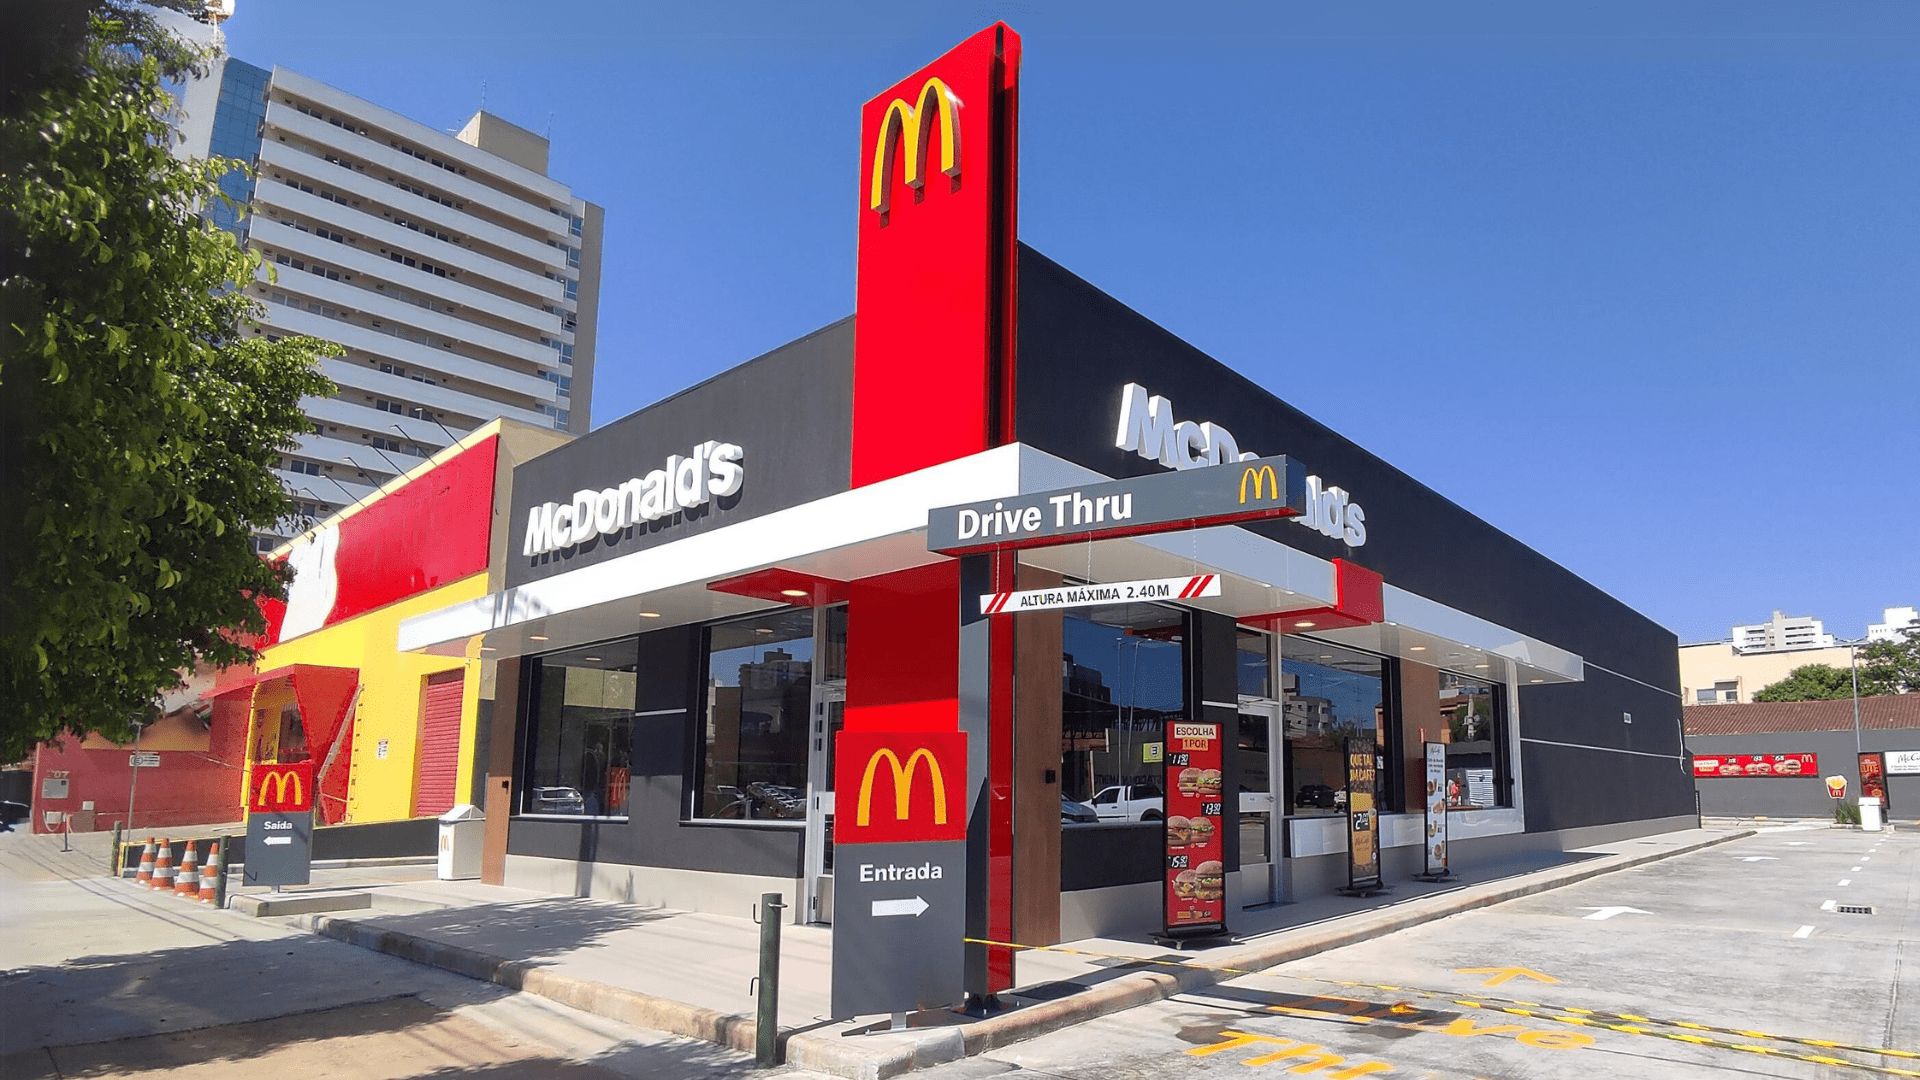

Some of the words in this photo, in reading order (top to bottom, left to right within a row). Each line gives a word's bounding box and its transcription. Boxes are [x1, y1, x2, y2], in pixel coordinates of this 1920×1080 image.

[1115, 382, 1366, 548] McDld's
[523, 440, 744, 556] McDonald's
[957, 502, 1041, 540] Drive
[1049, 491, 1132, 529] Thru
[1020, 591, 1064, 607] ALTURA
[1066, 586, 1120, 602] MÁXIMA
[1176, 727, 1214, 736] ESCOLHA
[860, 862, 943, 882] Entrada
